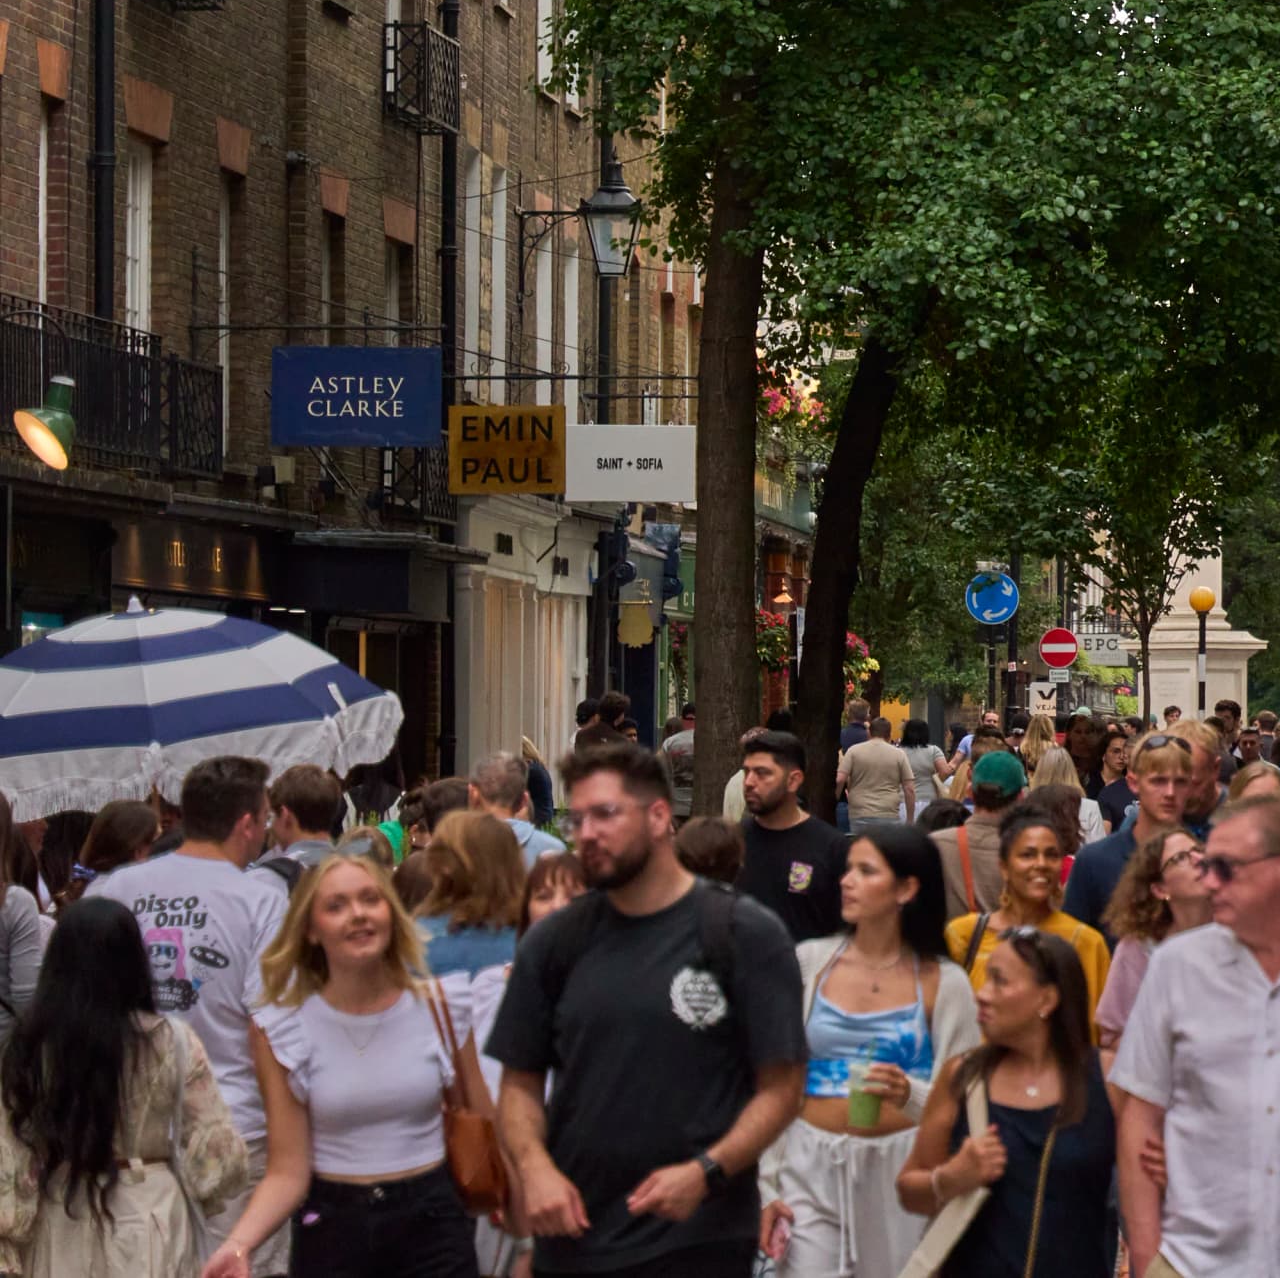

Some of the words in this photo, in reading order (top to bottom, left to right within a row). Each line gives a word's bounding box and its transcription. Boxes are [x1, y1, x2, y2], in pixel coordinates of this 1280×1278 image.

[308, 376, 405, 401] ASTLEY
[306, 399, 405, 418] CLARKE
[461, 415, 553, 442] EMIN
[461, 457, 553, 484] PAUL
[596, 457, 624, 470] SAINT
[636, 457, 663, 470] SOFIA
[133, 893, 199, 915] Disco
[154, 910, 209, 930] Only
